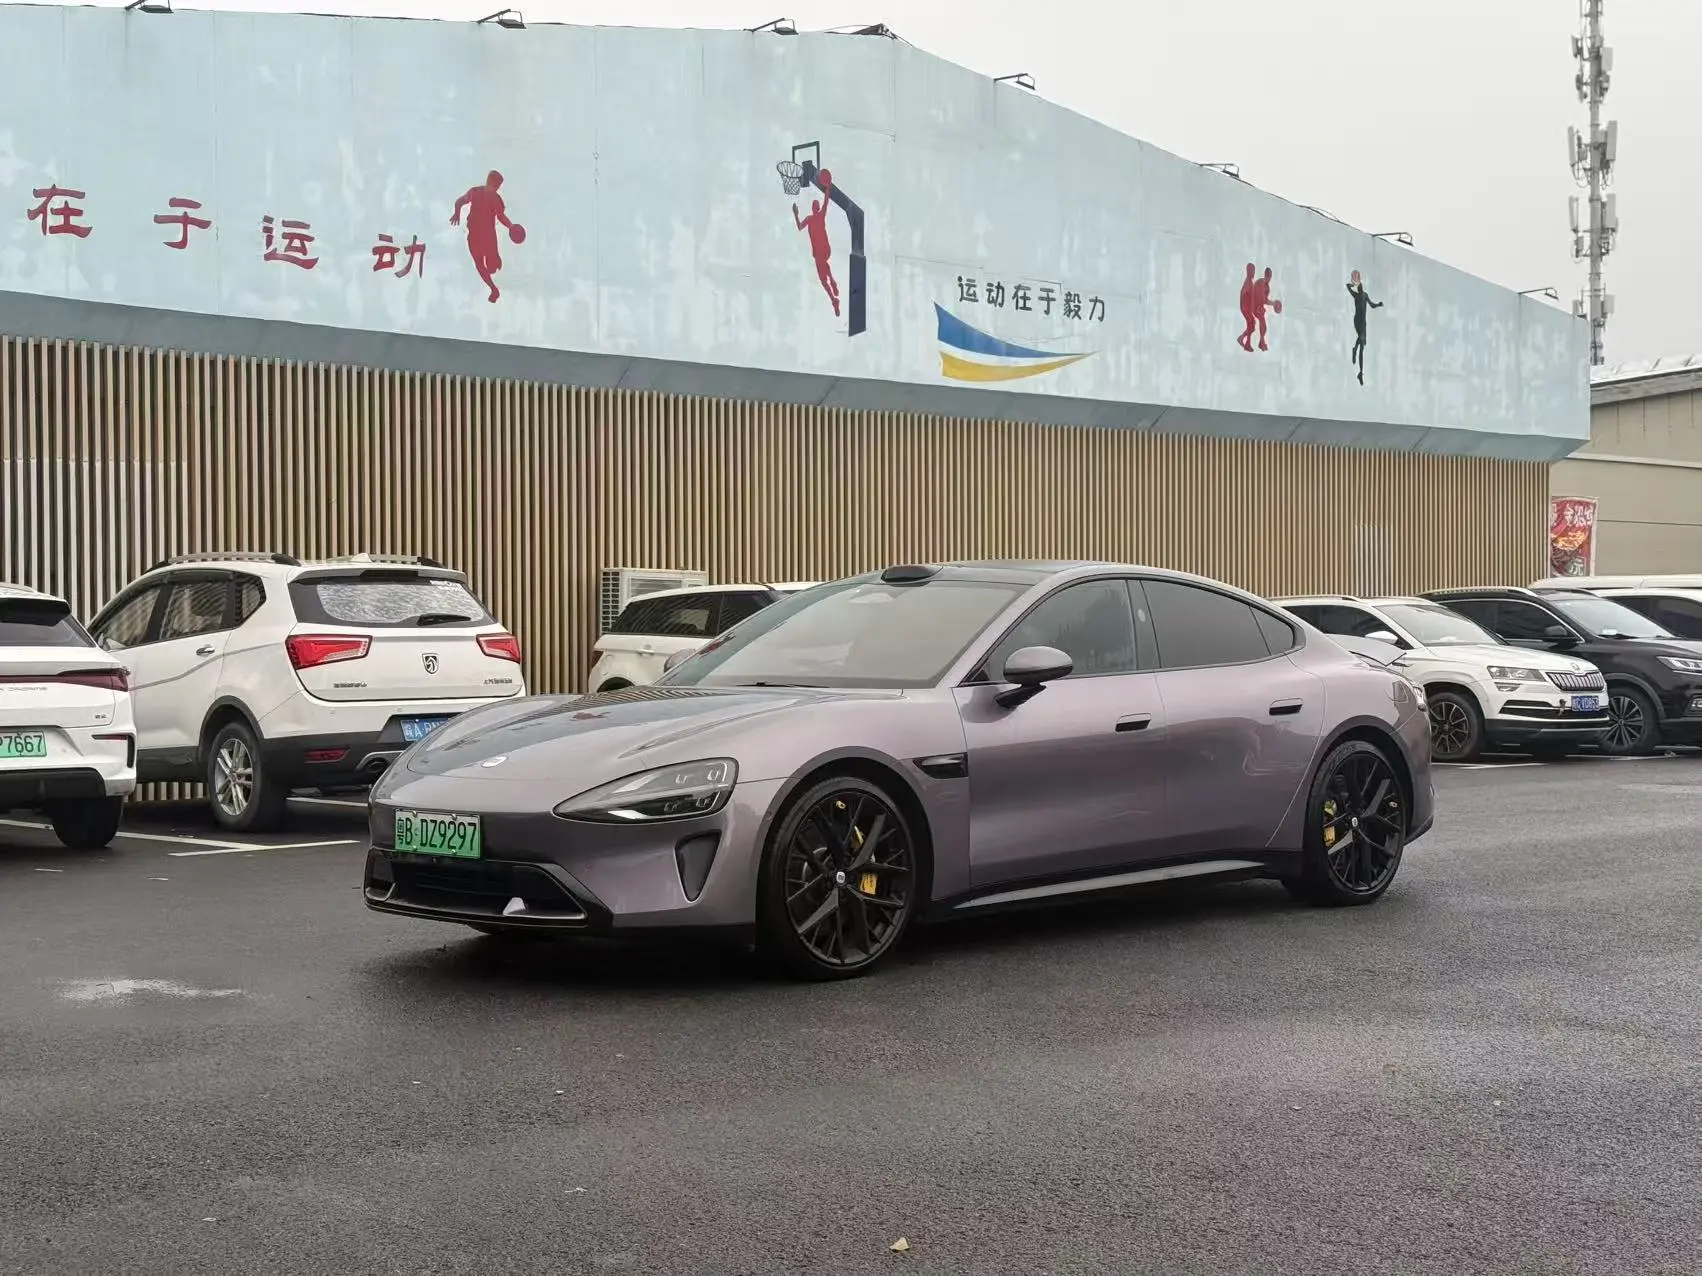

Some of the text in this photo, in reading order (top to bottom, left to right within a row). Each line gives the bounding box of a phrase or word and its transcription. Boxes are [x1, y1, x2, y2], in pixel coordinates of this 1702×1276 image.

[27, 183, 426, 279] 在于运动
[957, 276, 1105, 322] 运动在于毅力
[0, 735, 43, 753] 7667
